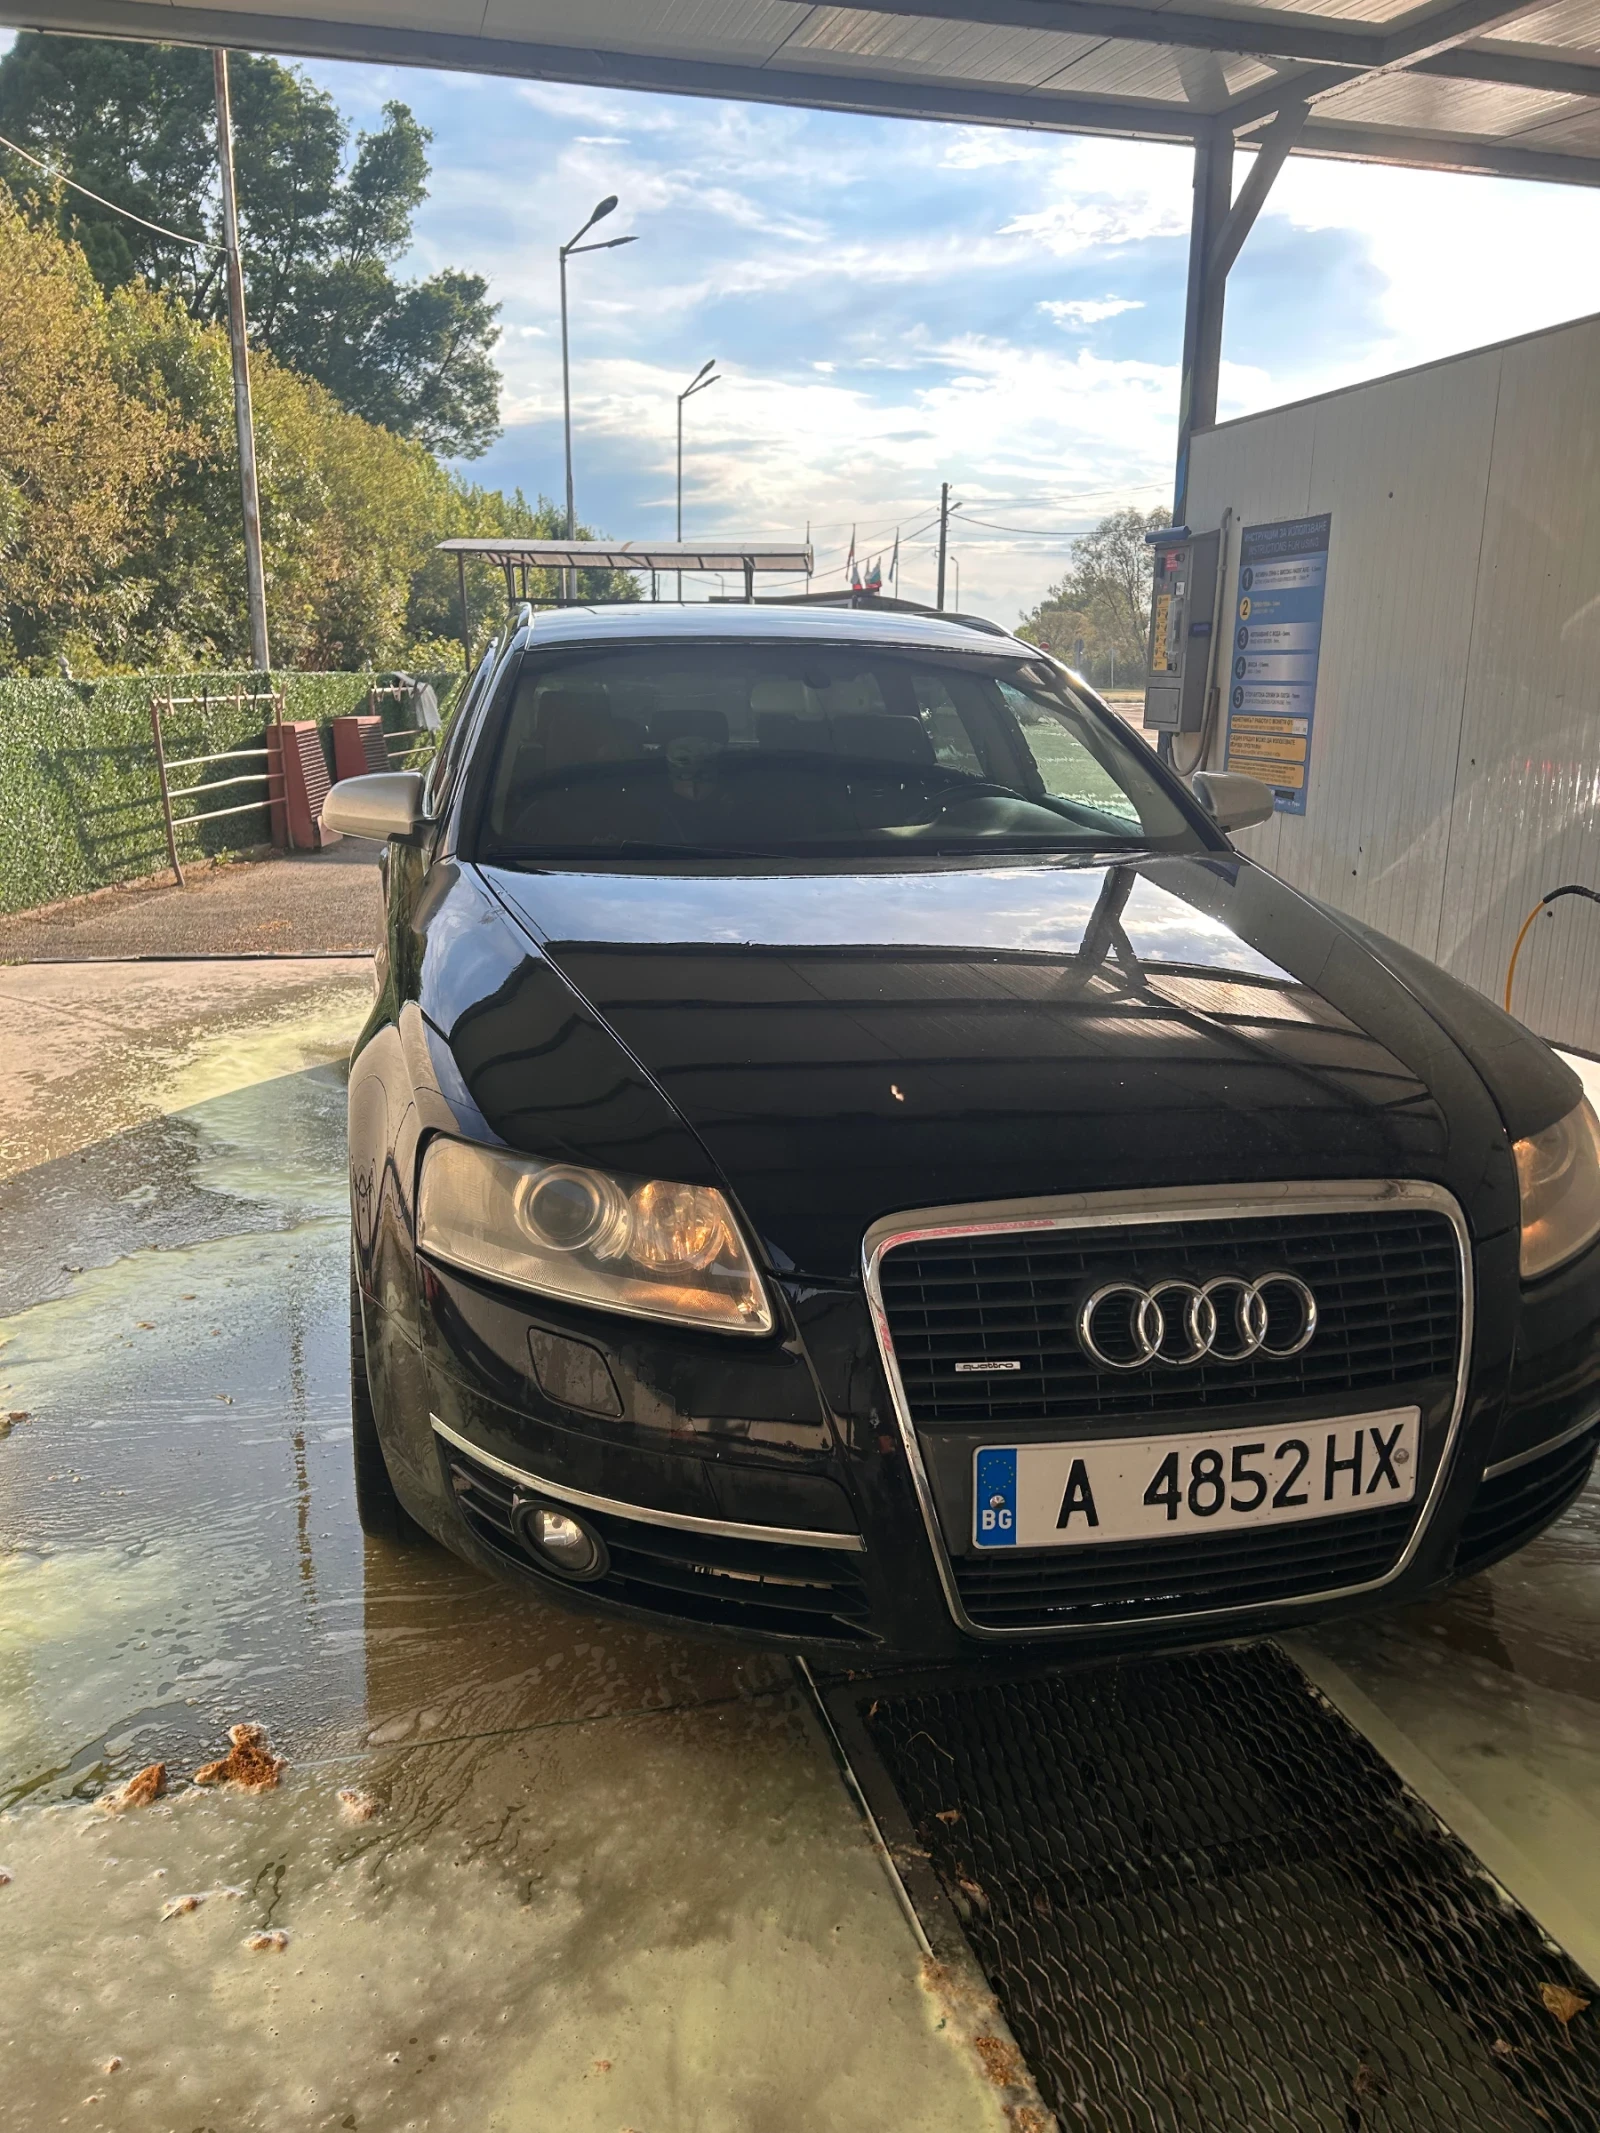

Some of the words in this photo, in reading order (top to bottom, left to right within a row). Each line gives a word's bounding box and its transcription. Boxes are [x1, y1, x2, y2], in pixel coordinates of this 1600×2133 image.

[1279, 527, 1287, 538] ЗА
[1248, 541, 1287, 556] INSTRUCTIONS
[1288, 539, 1300, 551] FOR
[1301, 536, 1319, 549] USING
[1242, 599, 1249, 616] 2
[1240, 631, 1247, 646] 3
[1236, 660, 1244, 678] 4
[963, 1362, 1014, 1371] quattro
[1056, 1459, 1100, 1529] A
[1143, 1439, 1310, 1521] 4852
[1324, 1424, 1404, 1501] HX
[981, 1509, 1012, 1530] BG
